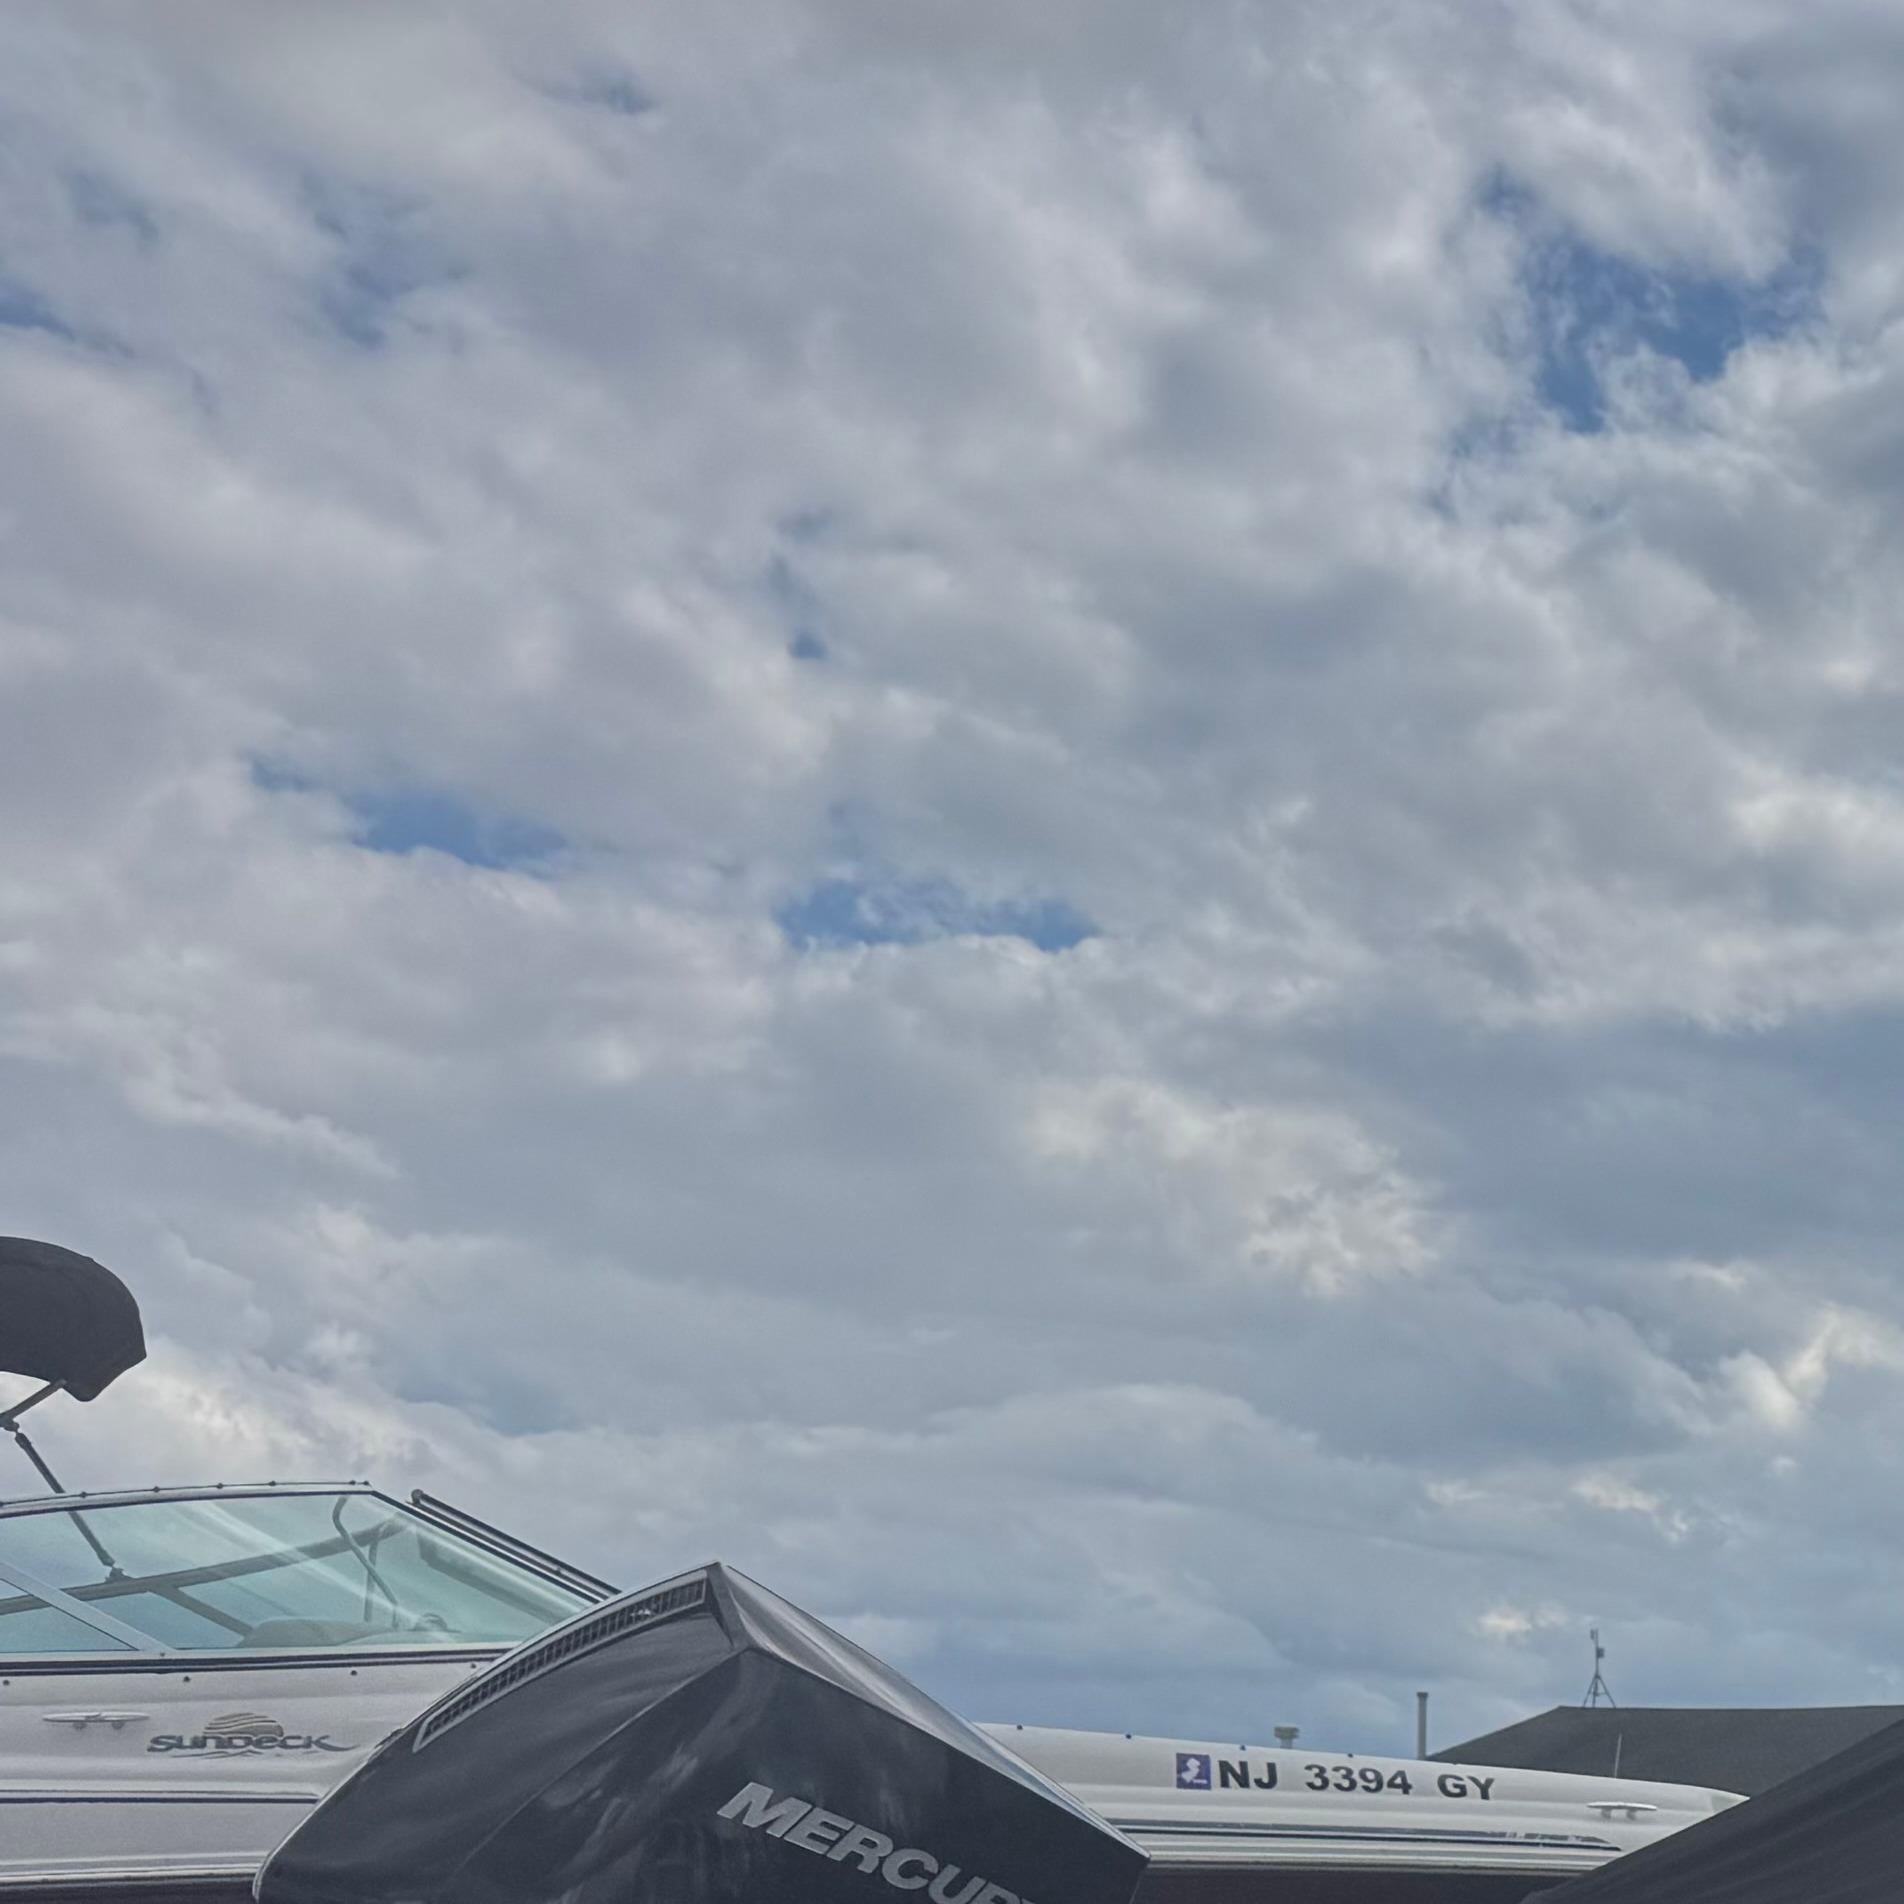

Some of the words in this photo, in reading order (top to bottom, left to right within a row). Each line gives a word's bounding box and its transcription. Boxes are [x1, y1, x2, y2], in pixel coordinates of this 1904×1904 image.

[1218, 1760, 1278, 1790] NJ
[1304, 1763, 1413, 1795] 3394
[1437, 1773, 1495, 1801] GY
